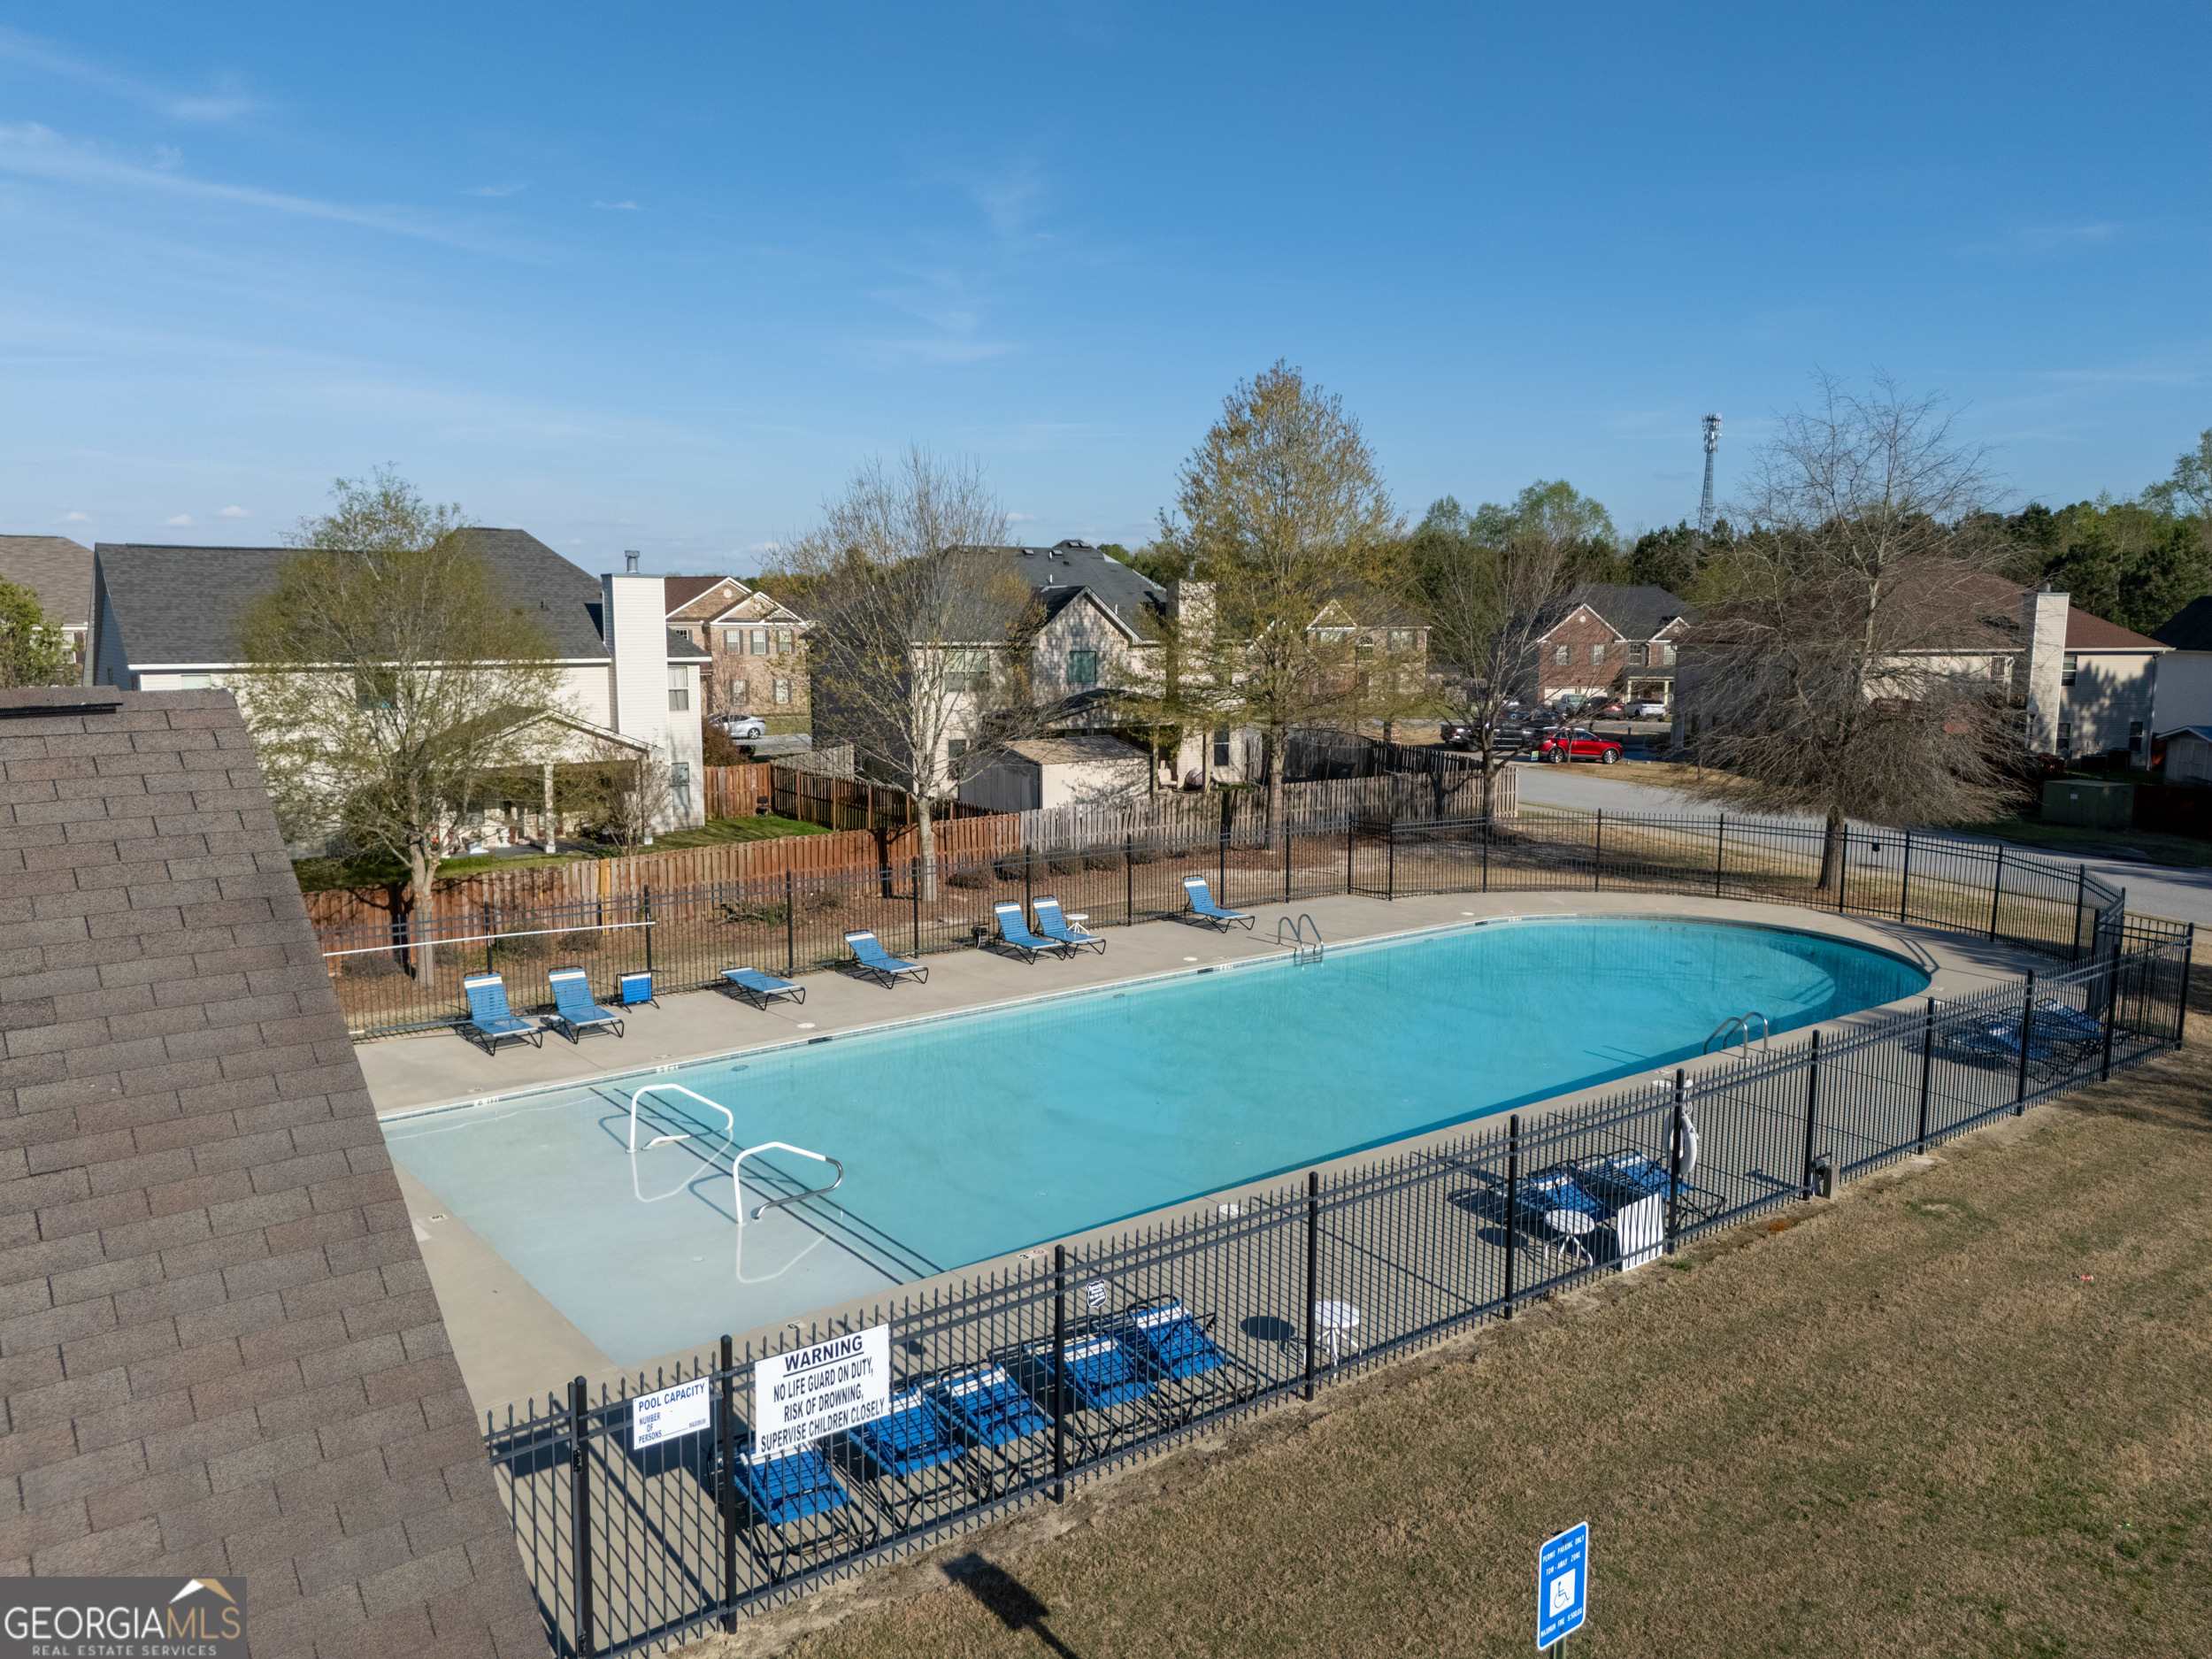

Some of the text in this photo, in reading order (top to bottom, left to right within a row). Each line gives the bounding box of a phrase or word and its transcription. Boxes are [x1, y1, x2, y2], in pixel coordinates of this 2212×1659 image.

[785, 1335, 863, 1372] WARNING
[773, 1356, 873, 1403] NO LIFE GUARD ON DUTY,
[639, 1382, 705, 1412] POOL CAPACITY
[784, 1383, 864, 1423] RISK OF DROWNING,
[639, 1411, 661, 1426] NUMBER
[646, 1423, 654, 1432] OF
[689, 1418, 706, 1428] MAXIMUM
[761, 1396, 886, 1453] SUPERVISE CHILDREN CLOSELY
[638, 1430, 663, 1444] PERSONS
[1543, 1535, 1584, 1563] PERMIT PARKING ONLY
[1571, 1551, 1580, 1562] ZONE
